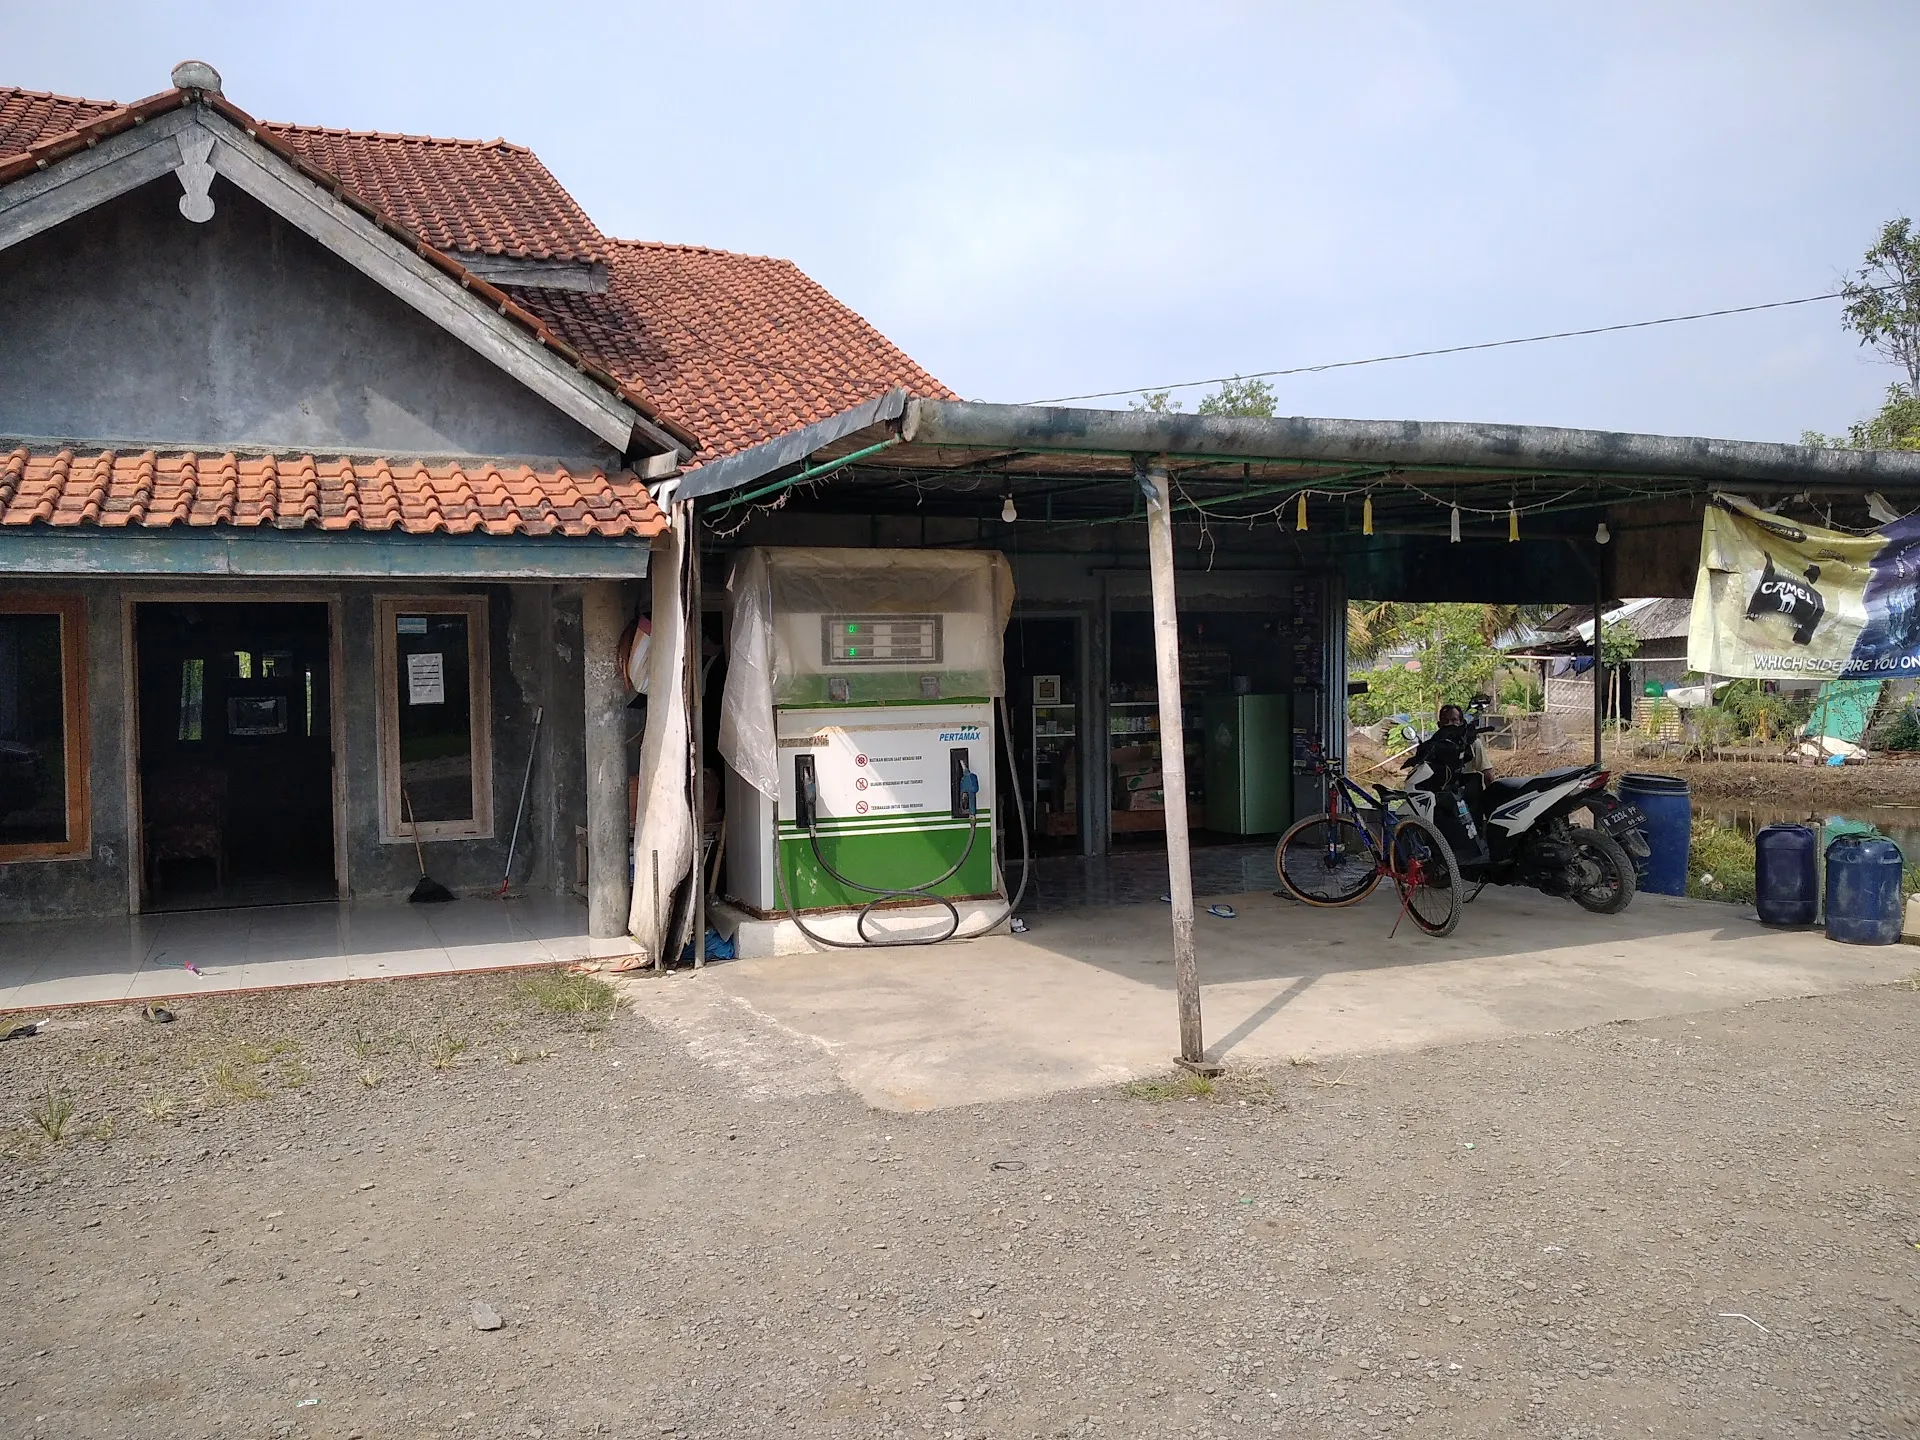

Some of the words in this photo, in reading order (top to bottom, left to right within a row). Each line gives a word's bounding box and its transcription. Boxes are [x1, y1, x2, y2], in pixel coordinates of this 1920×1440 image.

[1761, 581, 1814, 605] CAMEL
[1754, 654, 1803, 670] WHICH
[1805, 657, 1842, 672] SIDE
[1843, 659, 1873, 672] ARE
[1873, 657, 1899, 670] YOU
[939, 732, 981, 741] PERTAMAX
